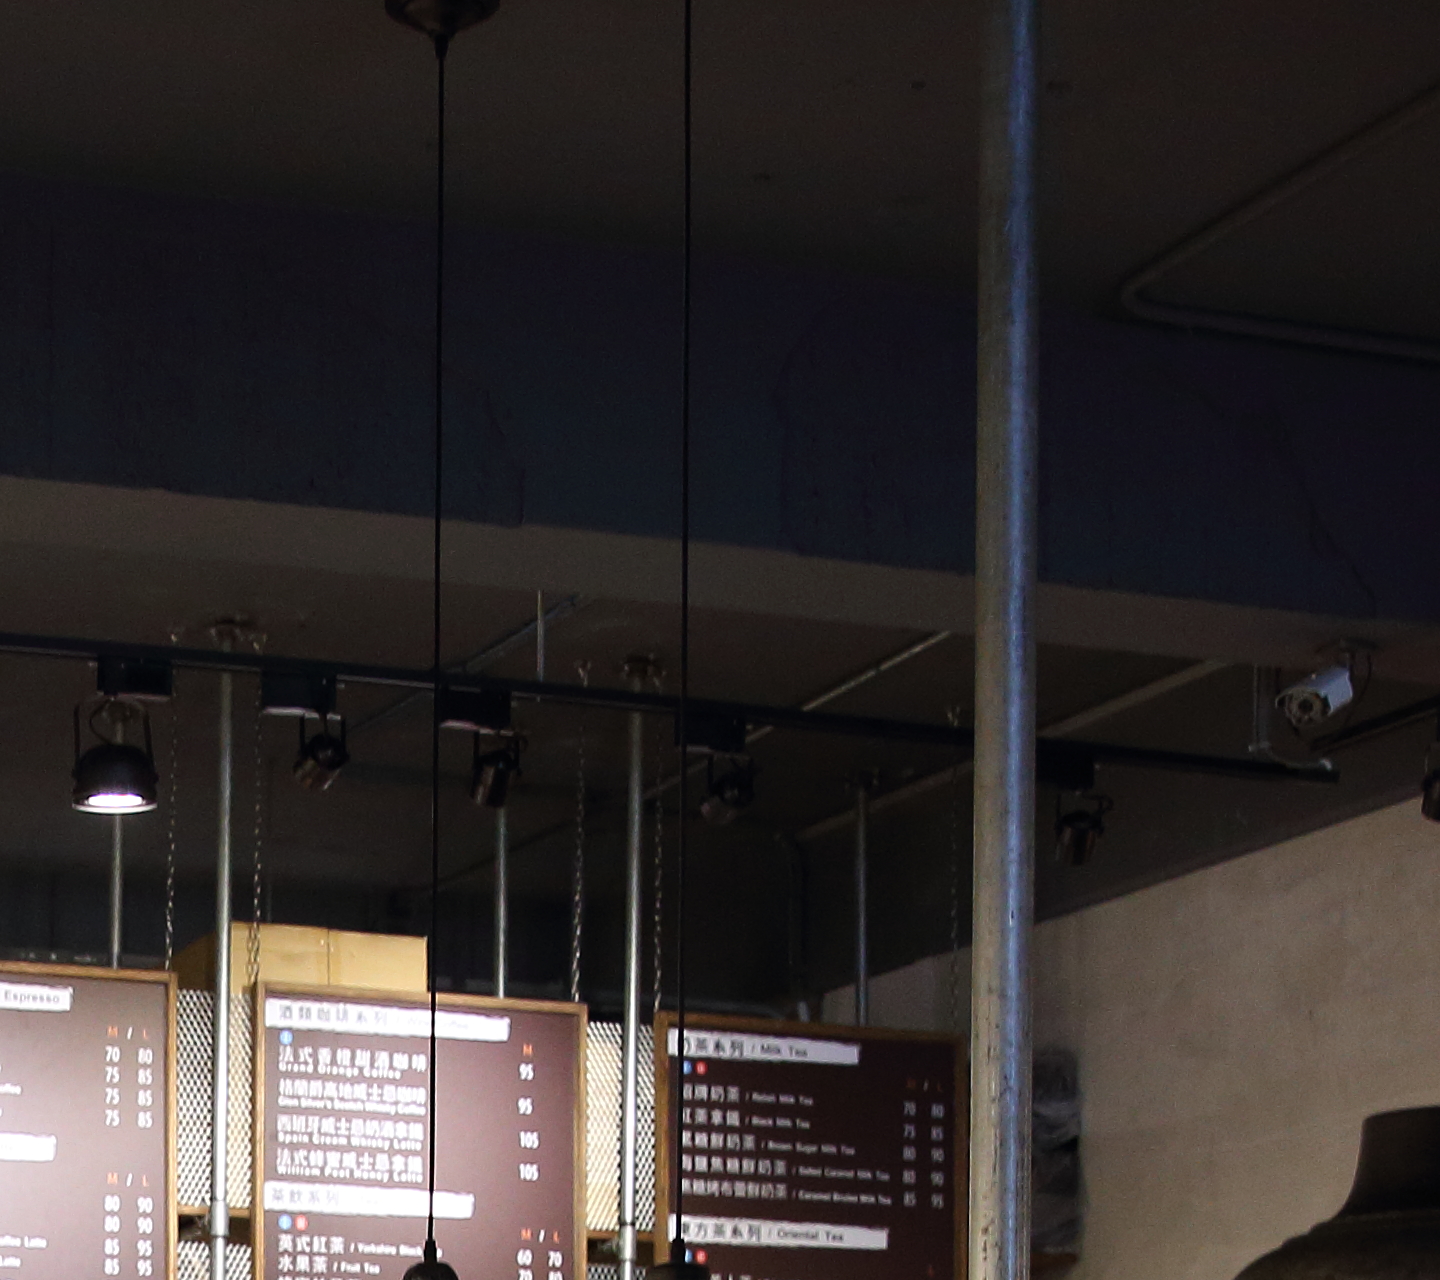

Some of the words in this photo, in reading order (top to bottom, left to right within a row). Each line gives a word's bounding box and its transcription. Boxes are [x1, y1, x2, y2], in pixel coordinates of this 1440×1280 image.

[4, 990, 60, 1004] Espresso
[105, 1047, 120, 1062] 70
[789, 1046, 808, 1058] Tea
[105, 1067, 119, 1084] 75
[138, 1069, 152, 1085] 85
[520, 1064, 534, 1080] 95
[105, 1088, 119, 1105] 75
[138, 1090, 152, 1107] 85
[518, 1098, 532, 1114] 95
[105, 1110, 119, 1126] 75
[138, 1112, 152, 1128] 85
[519, 1132, 538, 1149] 105
[519, 1164, 538, 1180] 105
[137, 1197, 152, 1213] 90
[137, 1217, 152, 1234] 90
[778, 1229, 818, 1240] Oriental
[826, 1232, 844, 1242] Tea
[104, 1239, 119, 1255] 85
[137, 1240, 152, 1257] 95
[278, 1254, 328, 1273] 水果茶
[548, 1251, 562, 1267] 70
[104, 1259, 119, 1275] 85
[137, 1260, 152, 1276] 95
